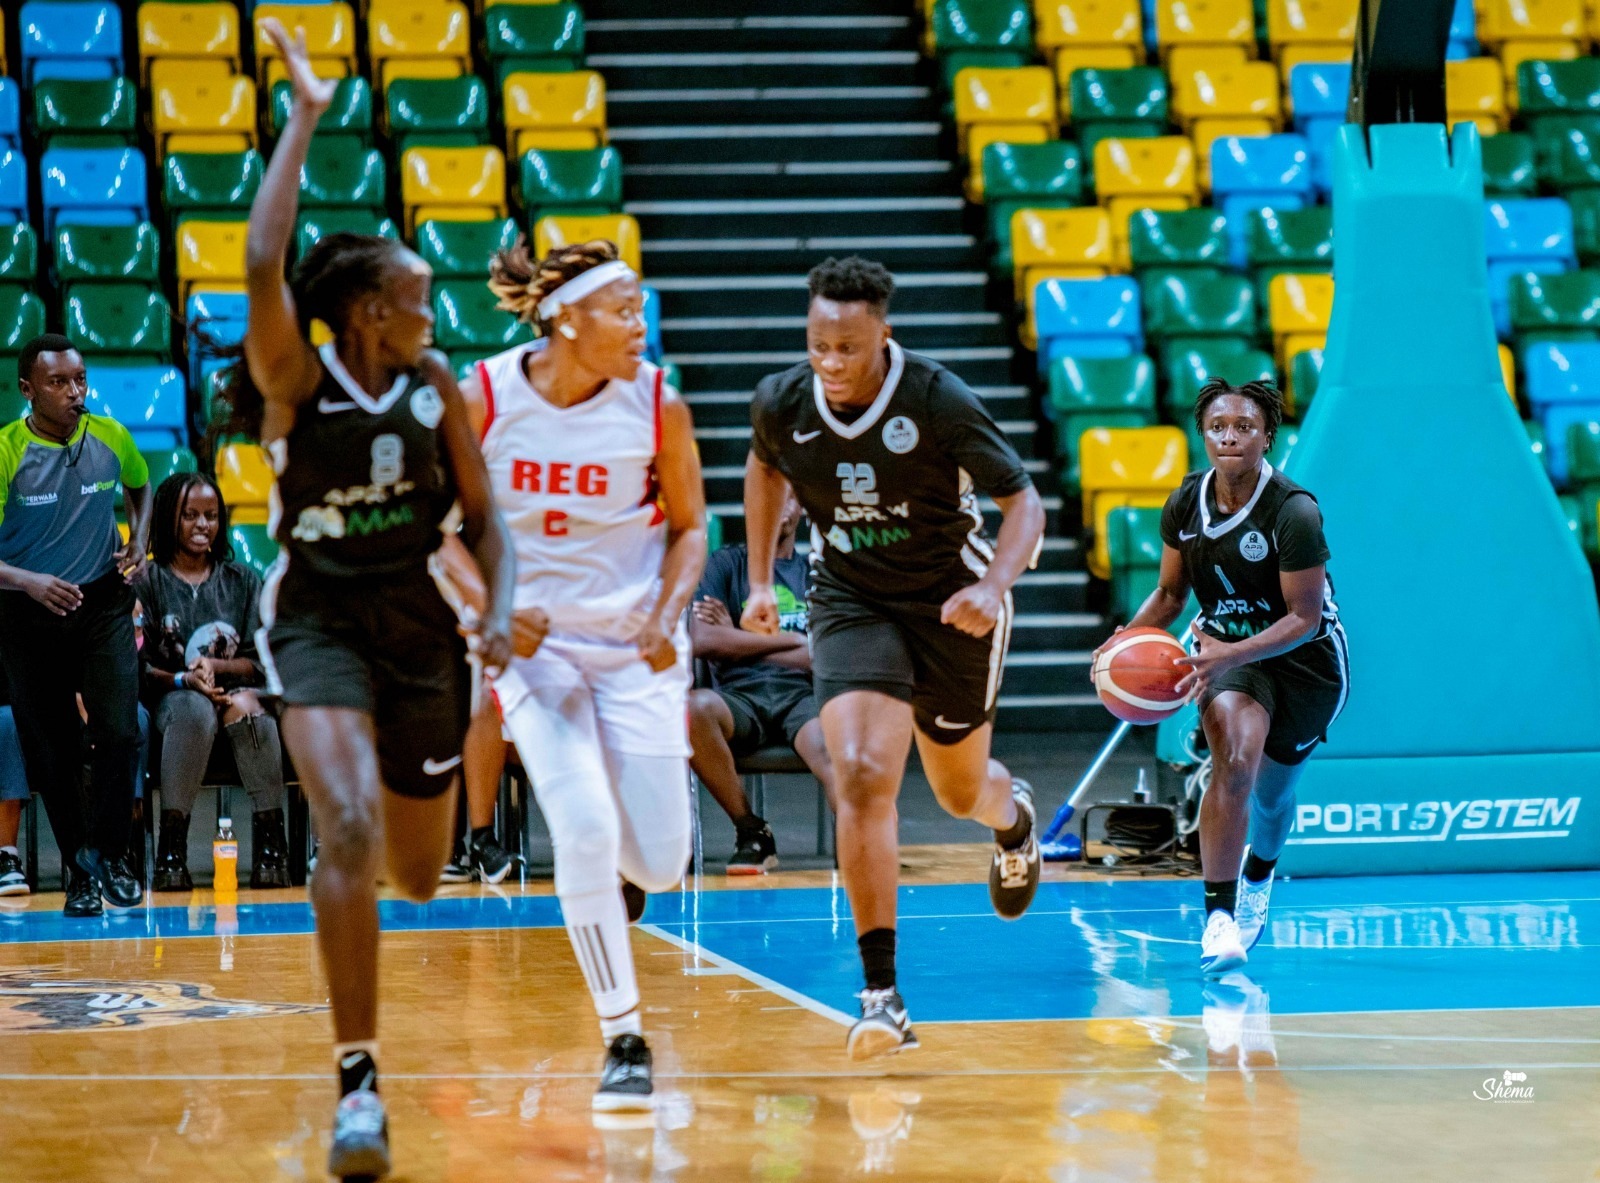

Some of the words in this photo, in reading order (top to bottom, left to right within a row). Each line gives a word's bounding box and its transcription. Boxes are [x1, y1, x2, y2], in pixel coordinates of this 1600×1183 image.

[370, 433, 405, 487] 8
[512, 458, 609, 497] REG
[836, 462, 880, 505] 32
[1214, 564, 1236, 595] 1
